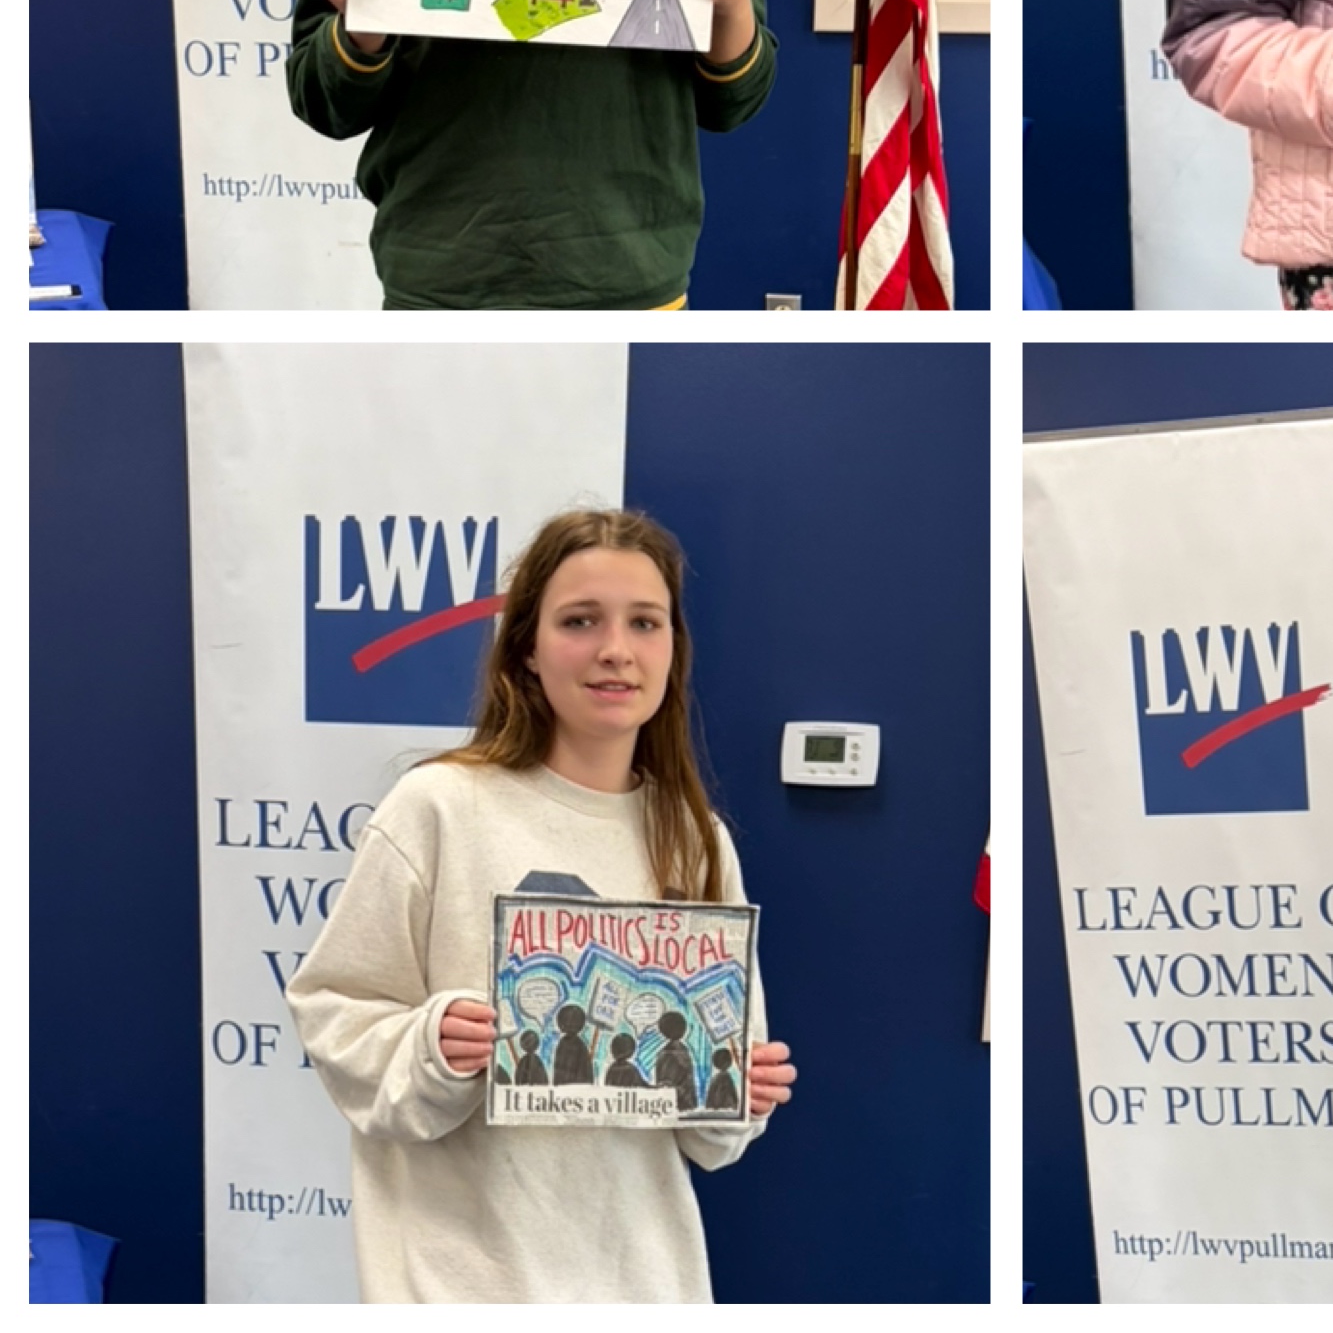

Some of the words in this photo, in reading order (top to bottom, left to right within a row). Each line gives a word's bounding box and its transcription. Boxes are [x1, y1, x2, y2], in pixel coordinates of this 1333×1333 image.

[184, 40, 241, 77] OF
[315, 515, 498, 611] LWV
[1146, 622, 1299, 715] LWV
[655, 912, 682, 931] IS
[1073, 885, 1303, 932] LEAGUE
[508, 910, 549, 956] ALL
[556, 909, 650, 965] POLITICS
[654, 928, 733, 975] LOCAL
[213, 1020, 281, 1066] OF
[504, 1089, 521, 1112] It
[527, 1090, 584, 1113] takes
[587, 1096, 600, 1112] a
[603, 1092, 673, 1117] village
[1089, 1085, 1147, 1125] OF
